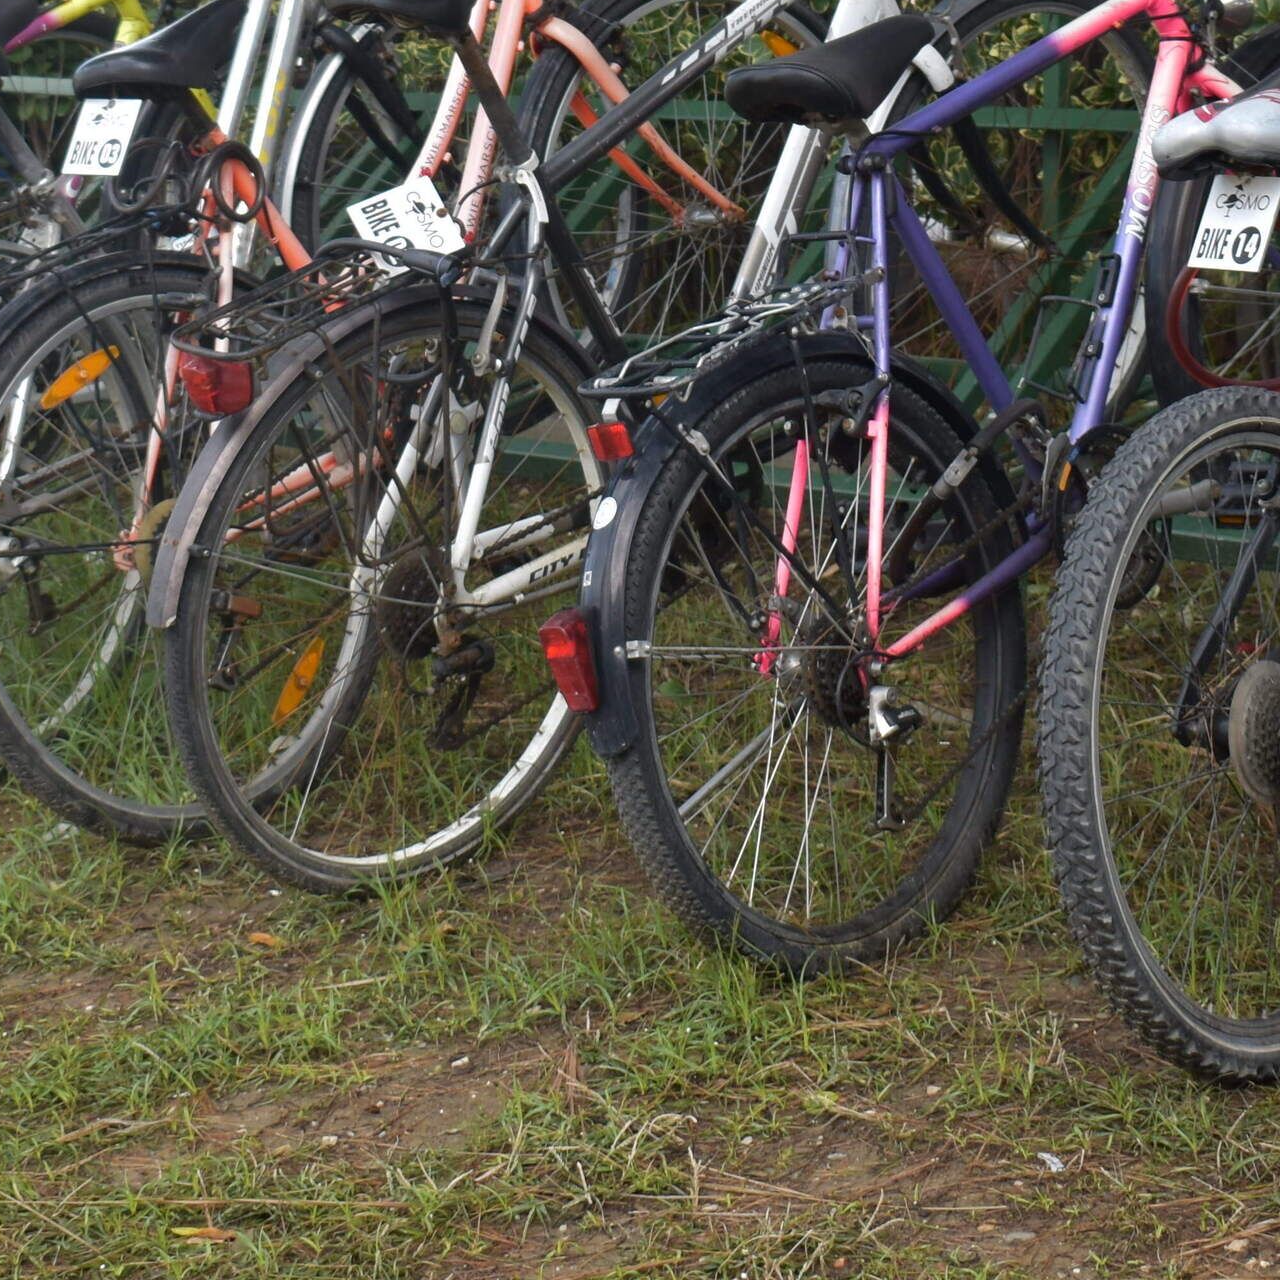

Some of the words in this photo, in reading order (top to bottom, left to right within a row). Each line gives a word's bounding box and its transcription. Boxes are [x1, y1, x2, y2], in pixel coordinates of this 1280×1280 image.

[70, 140, 98, 165] BIKE
[360, 198, 401, 237] BIKE
[1196, 227, 1232, 260] BIKE
[1235, 232, 1260, 259] 14
[529, 553, 574, 584] CITY
